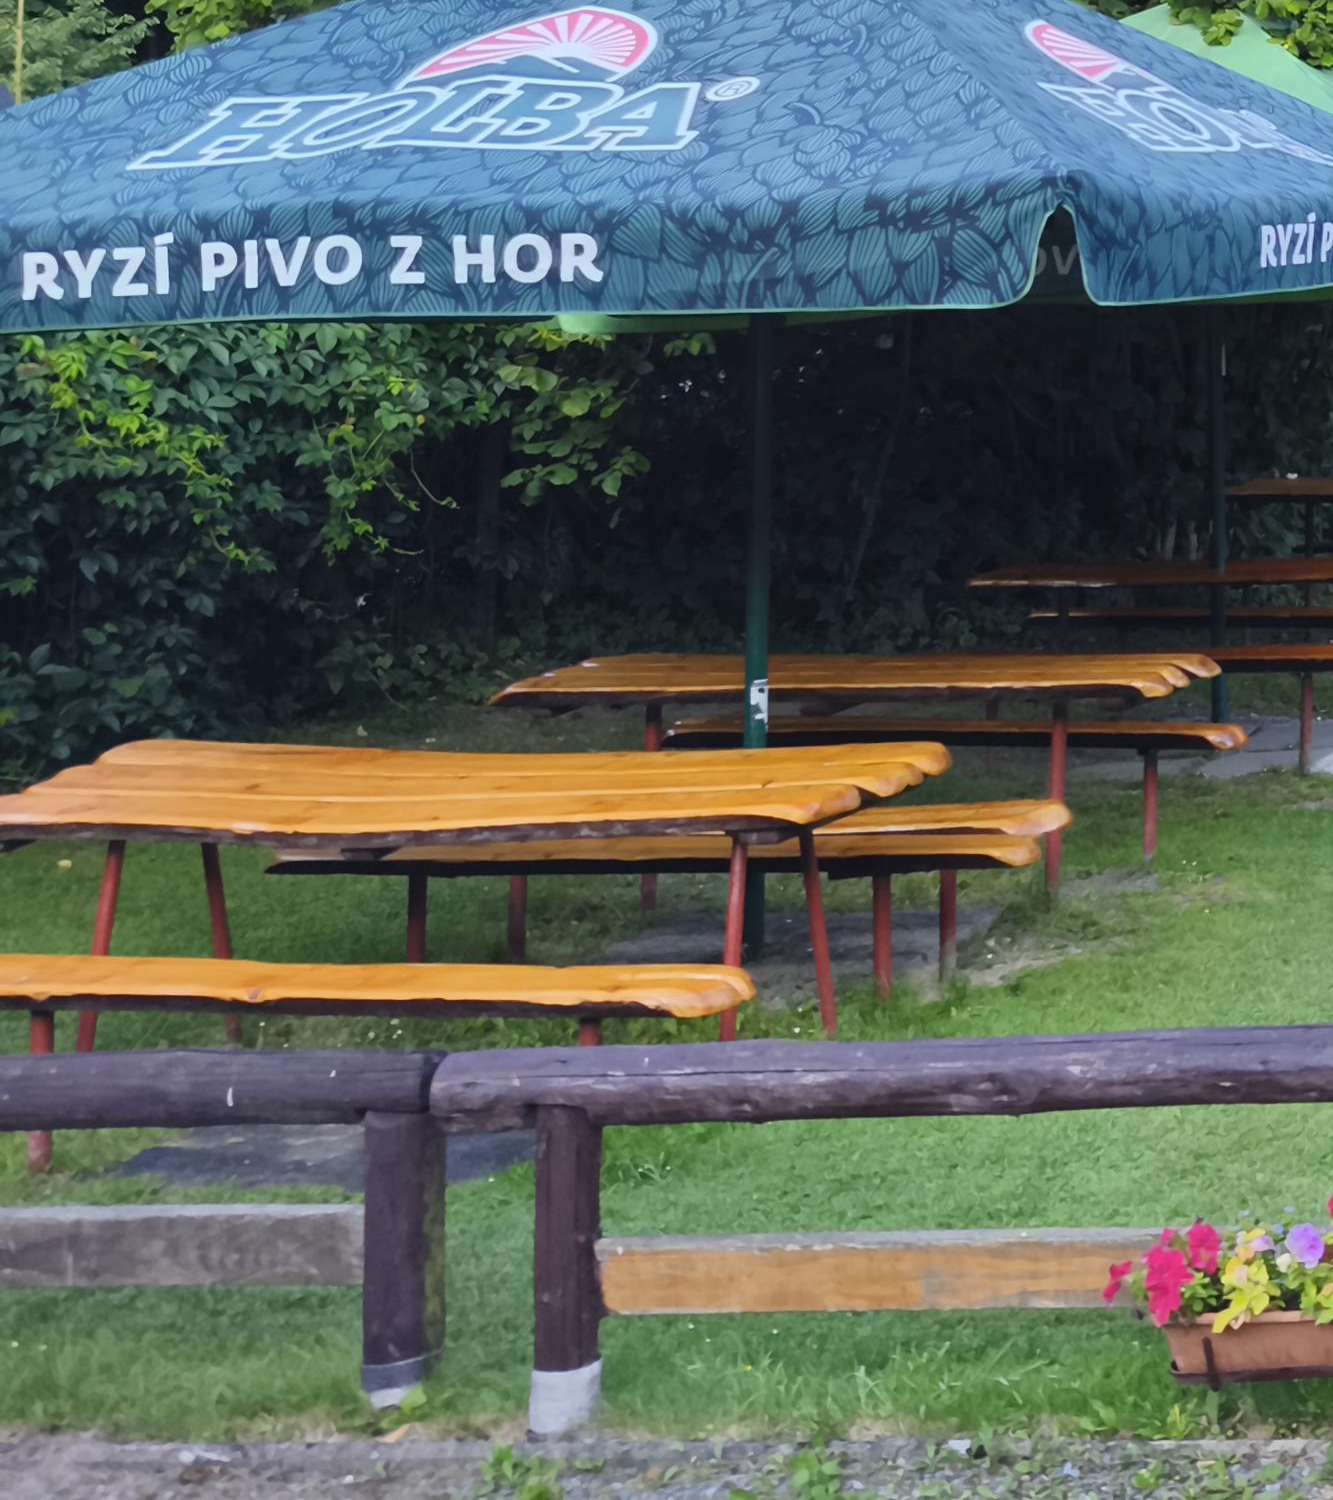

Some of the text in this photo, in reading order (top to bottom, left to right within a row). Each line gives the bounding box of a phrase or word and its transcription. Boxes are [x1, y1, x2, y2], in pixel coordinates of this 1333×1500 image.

[127, 75, 701, 170] HOLBA
[22, 232, 604, 300] RYZÍ PIVO Z HOR
[1259, 212, 1316, 268] RYZÍ
